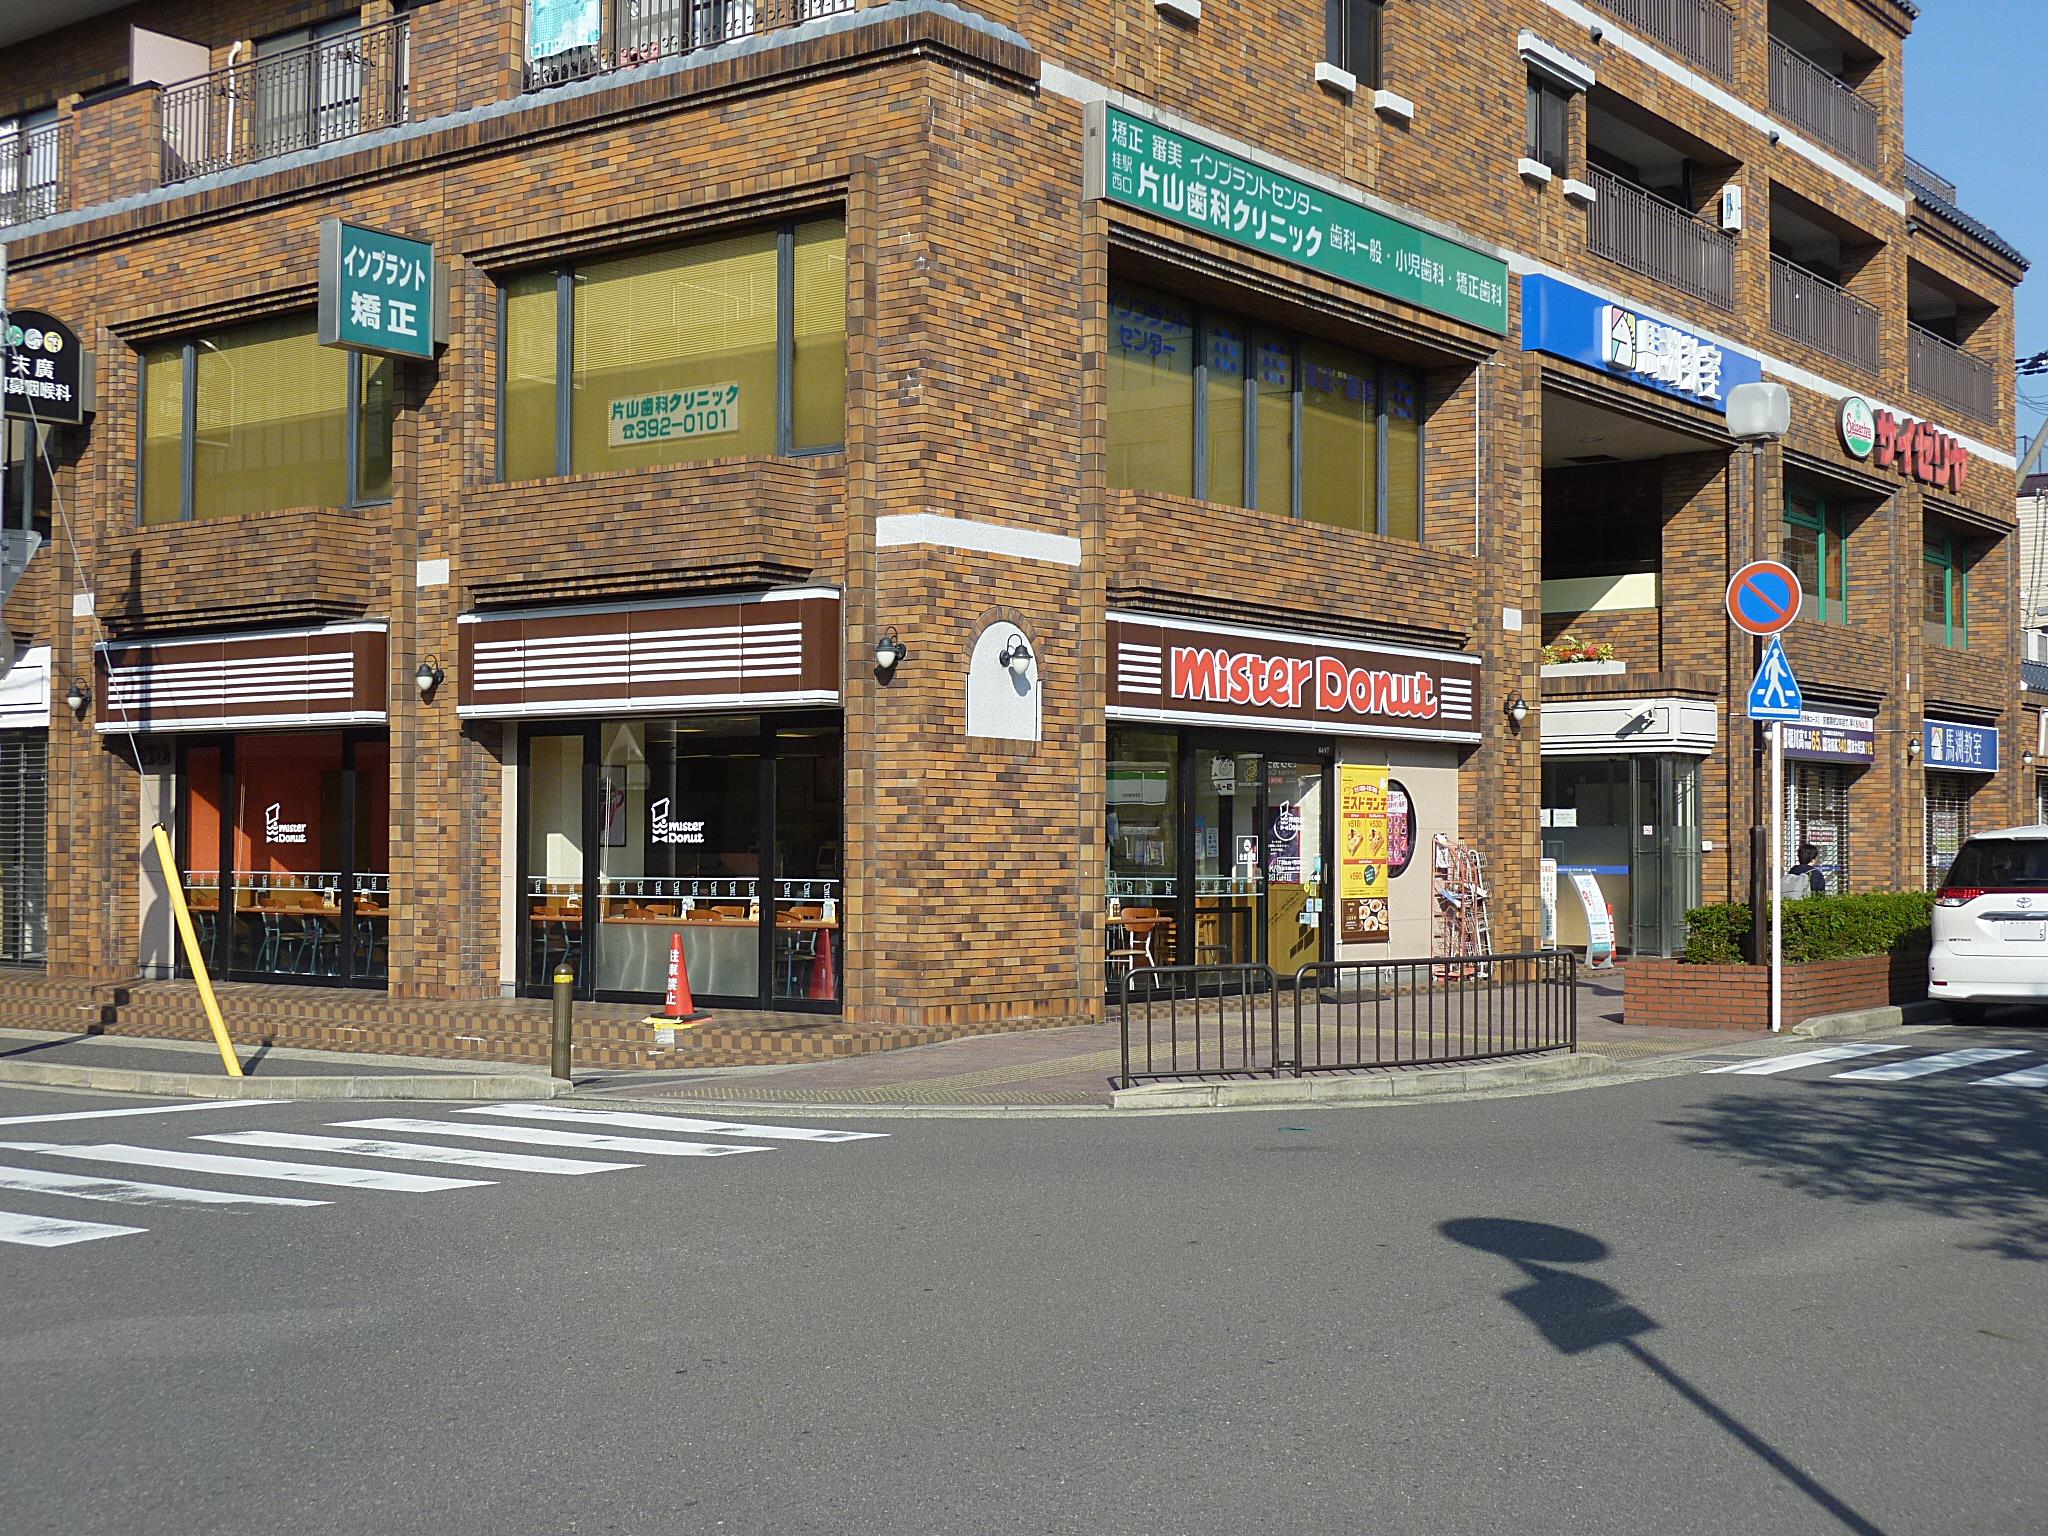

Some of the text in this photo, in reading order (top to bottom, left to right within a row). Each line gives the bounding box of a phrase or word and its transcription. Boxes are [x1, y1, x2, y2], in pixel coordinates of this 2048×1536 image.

[1112, 152, 1132, 174] 桂駅
[1112, 118, 1323, 215] 矯正 審美 インプラントセンター
[1112, 171, 1132, 194] 西口
[1138, 162, 1322, 257] 片山歯科クリニック
[344, 245, 426, 291] インプラント
[351, 290, 418, 336] 矯正
[1119, 324, 1176, 365] センター
[11, 355, 55, 379] 末廣
[611, 385, 738, 420] 片山歯科クリニック
[1874, 409, 1968, 494] サイゼリヤ
[1316, 656, 1438, 719] Donut
[1343, 796, 1387, 810] ミスドランチ
[279, 834, 306, 842] Donut
[669, 833, 704, 843] Donut
